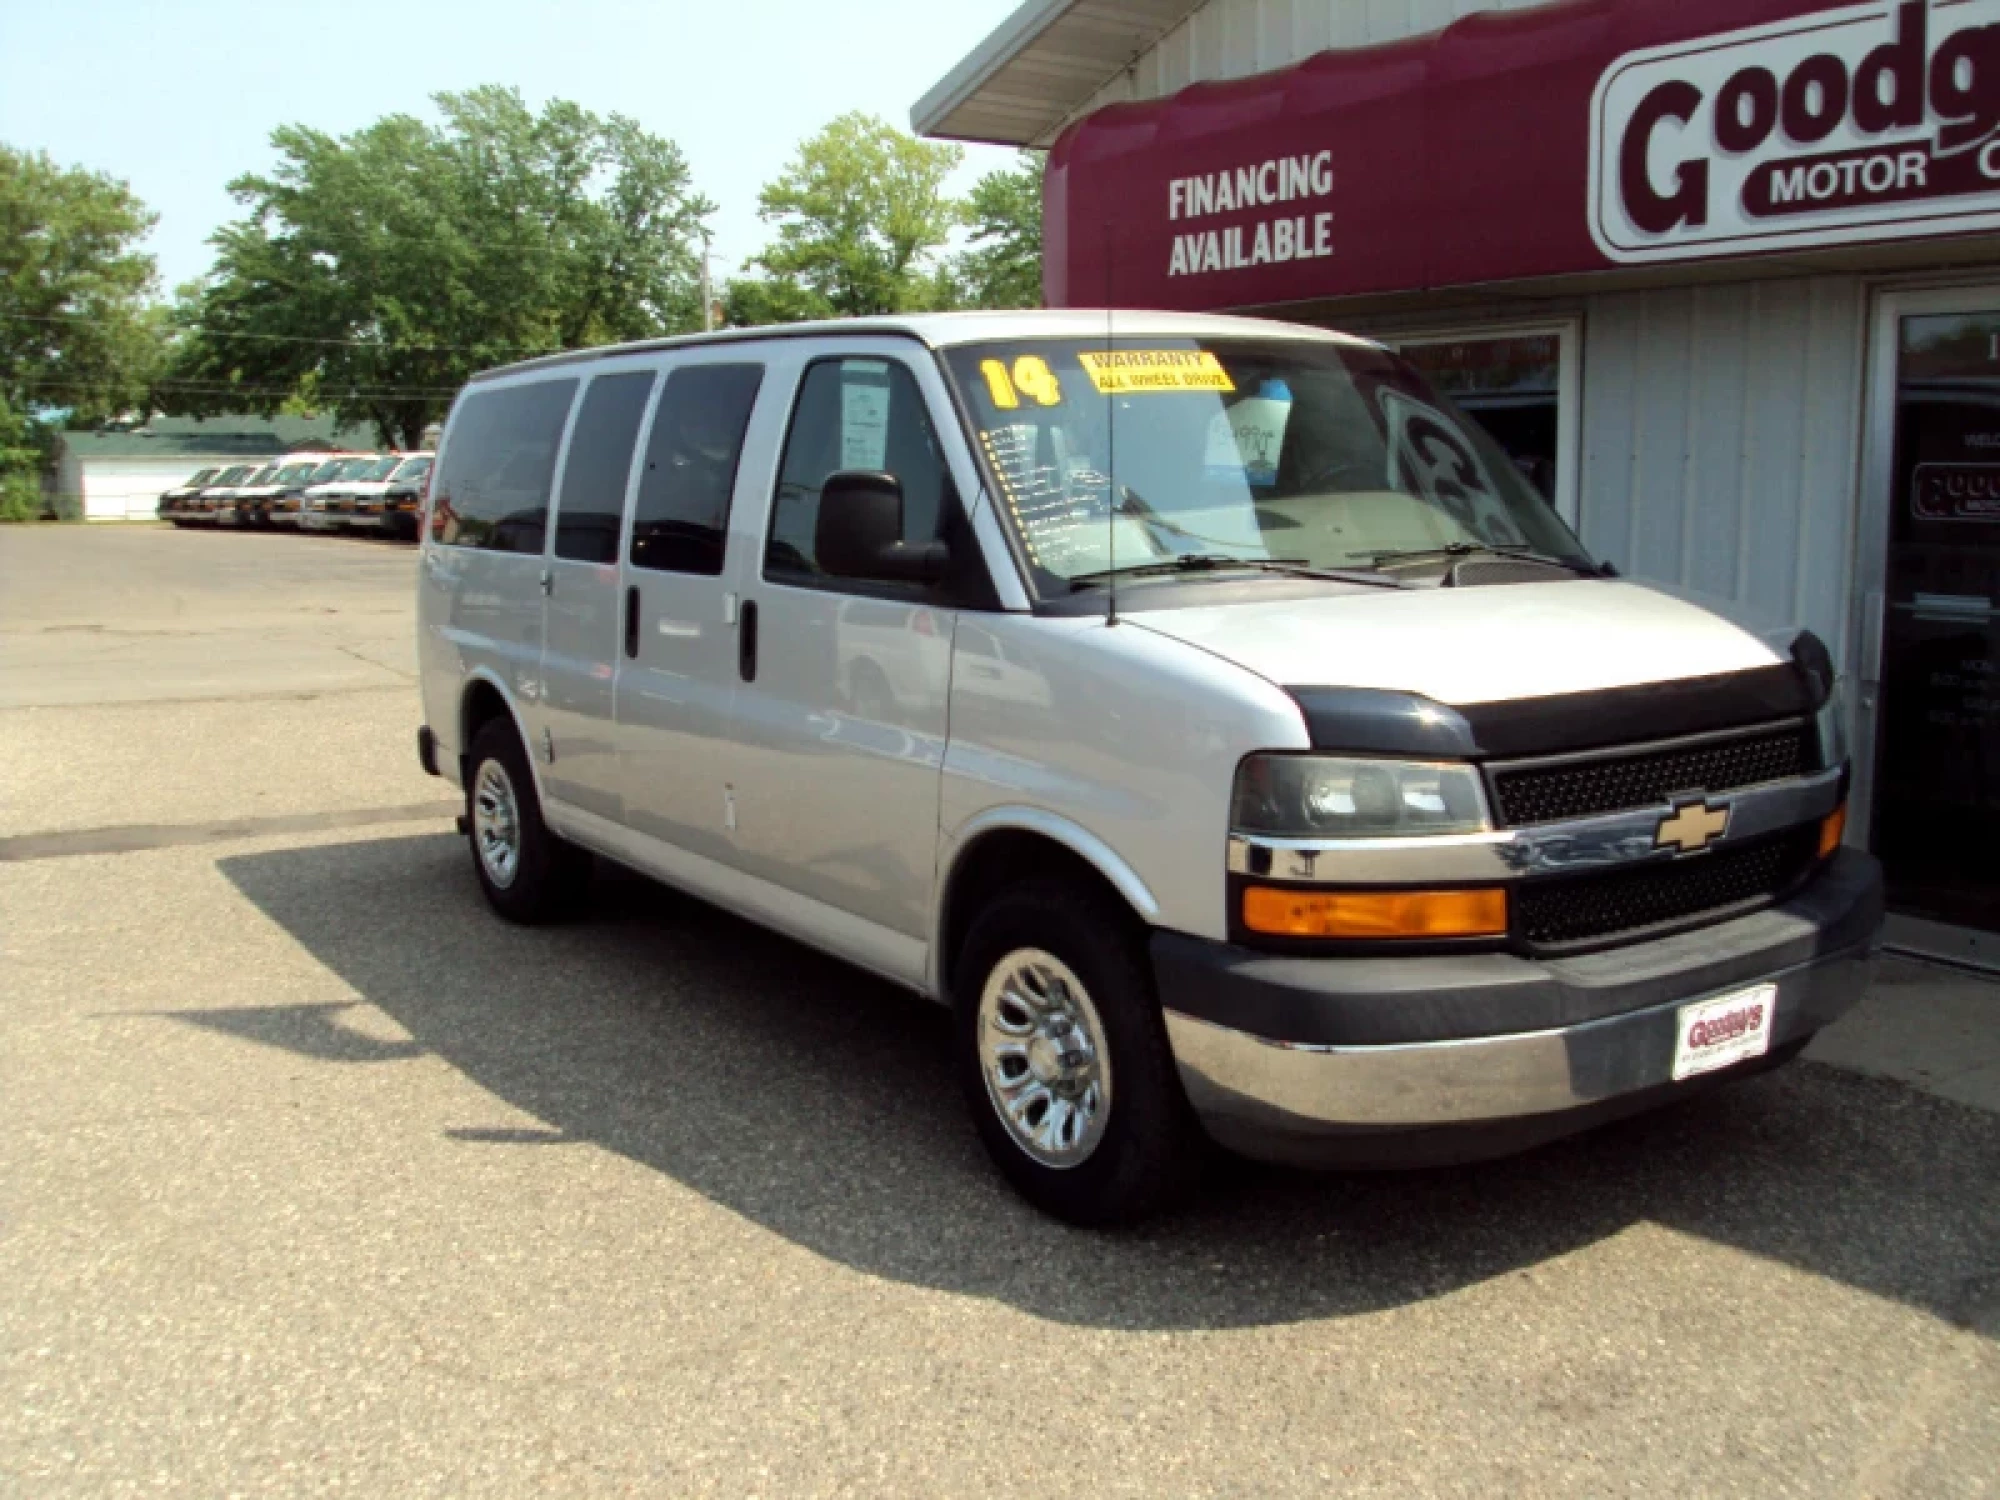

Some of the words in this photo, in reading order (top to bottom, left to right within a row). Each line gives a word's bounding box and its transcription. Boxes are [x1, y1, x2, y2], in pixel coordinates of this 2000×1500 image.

[1169, 150, 1333, 220] FINANCING
[1770, 151, 1927, 204] MOTOR
[1168, 212, 1334, 277] AVAILABLE
[980, 355, 1060, 408] 14
[1092, 351, 1203, 368] WARRANTY
[1100, 374, 1125, 388] ALL
[1129, 373, 1181, 386] WHEEL
[1183, 372, 1226, 386] DRIVE
